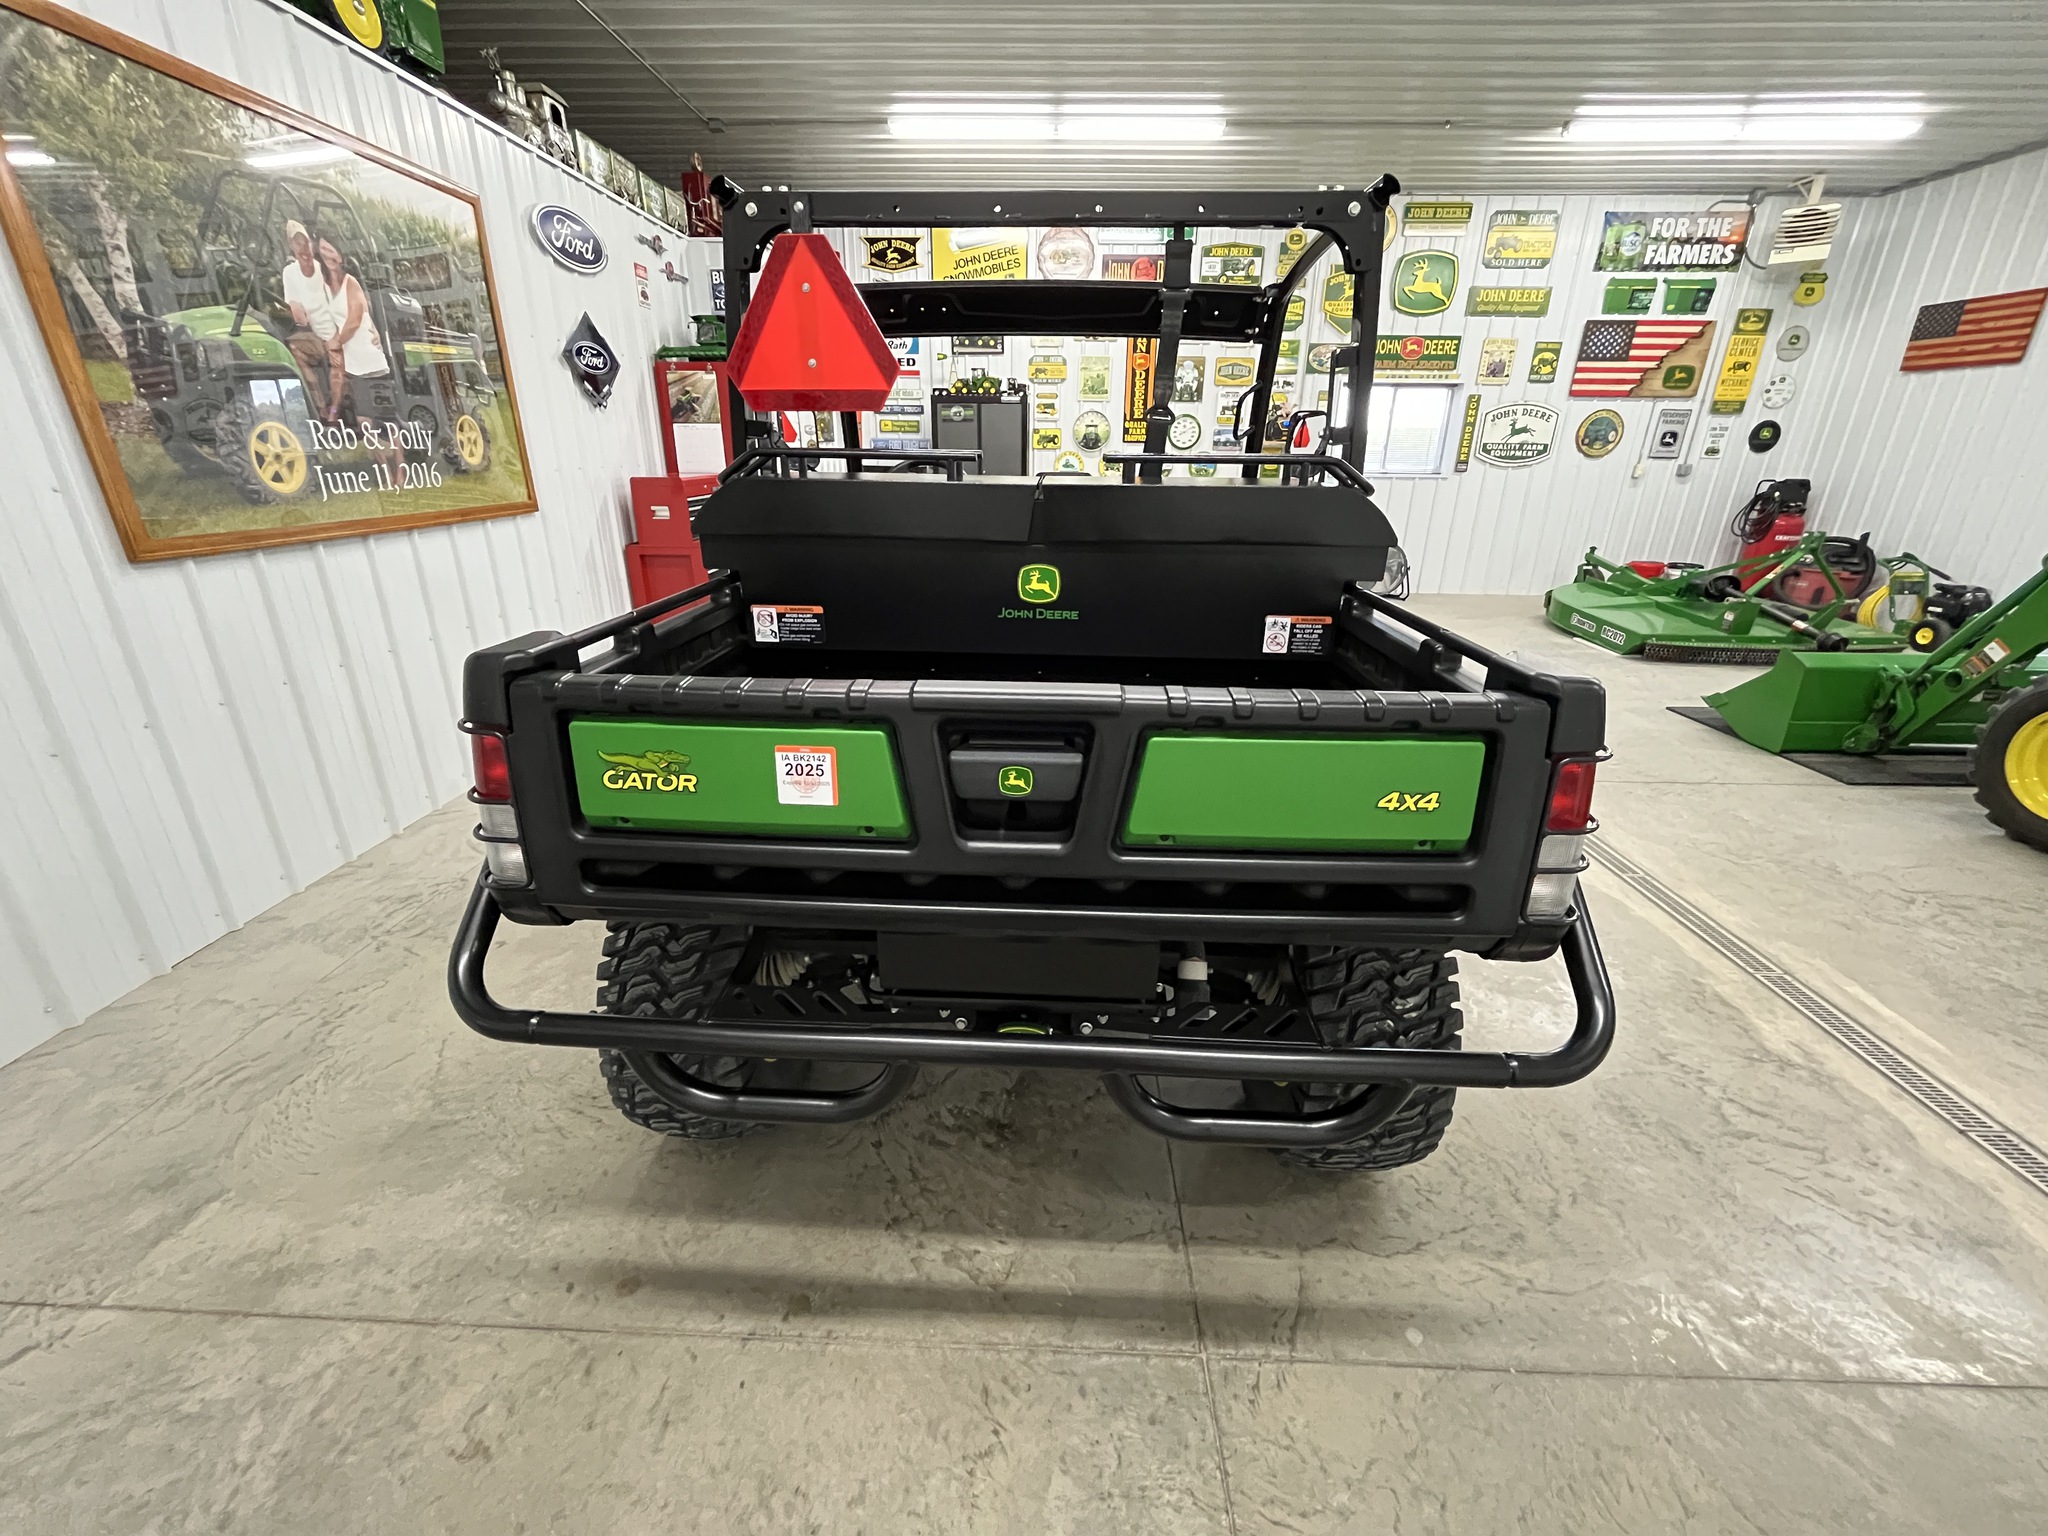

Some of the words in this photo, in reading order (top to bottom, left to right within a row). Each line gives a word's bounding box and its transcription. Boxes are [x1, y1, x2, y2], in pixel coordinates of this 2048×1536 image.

[1408, 207, 1435, 218] JOHN
[1435, 207, 1470, 218] DEERE
[1495, 213, 1518, 226] JOHN
[1528, 213, 1556, 226] DEERE
[1649, 217, 1691, 239] FOR
[1696, 217, 1734, 239] THE
[550, 214, 596, 261] Ford
[871, 240, 889, 254] JOHN
[891, 239, 916, 254] DEERE
[1210, 247, 1230, 257] JOHN
[1231, 247, 1254, 257] DEERE
[1643, 244, 1737, 265] FARMERS
[953, 254, 982, 271] JOHN
[983, 244, 1020, 263] DEERE
[1489, 258, 1515, 268] SOLD
[1517, 258, 1543, 268] HERE
[1105, 260, 1131, 281] JOHN
[1476, 289, 1507, 302] JOHN
[1508, 289, 1546, 302] DEERE
[1423, 339, 1459, 355] DEERE
[1732, 337, 1761, 347] SERVICE
[580, 346, 605, 370] Ford
[1728, 347, 1758, 357] CENTER
[1133, 369, 1146, 419] DEERE
[1466, 395, 1478, 423] JOHN
[1491, 407, 1518, 423] JOHN
[1521, 407, 1554, 423] DEERE
[306, 419, 359, 454] Rob
[361, 421, 385, 454] &
[384, 421, 433, 459] Polly
[1460, 426, 1473, 461] DEERE
[1486, 443, 1520, 451] QUALITY
[1522, 443, 1545, 451] FARM
[1489, 450, 1539, 458] EQUIPMENT
[313, 465, 372, 503] June
[371, 463, 401, 496] 11,
[402, 462, 443, 491] 2016
[997, 607, 1034, 619] JOHN
[1036, 608, 1080, 621] DEERE
[781, 754, 791, 762] IA
[793, 754, 827, 763] BK2142
[785, 763, 825, 777] 2025
[601, 770, 699, 794] GATOR
